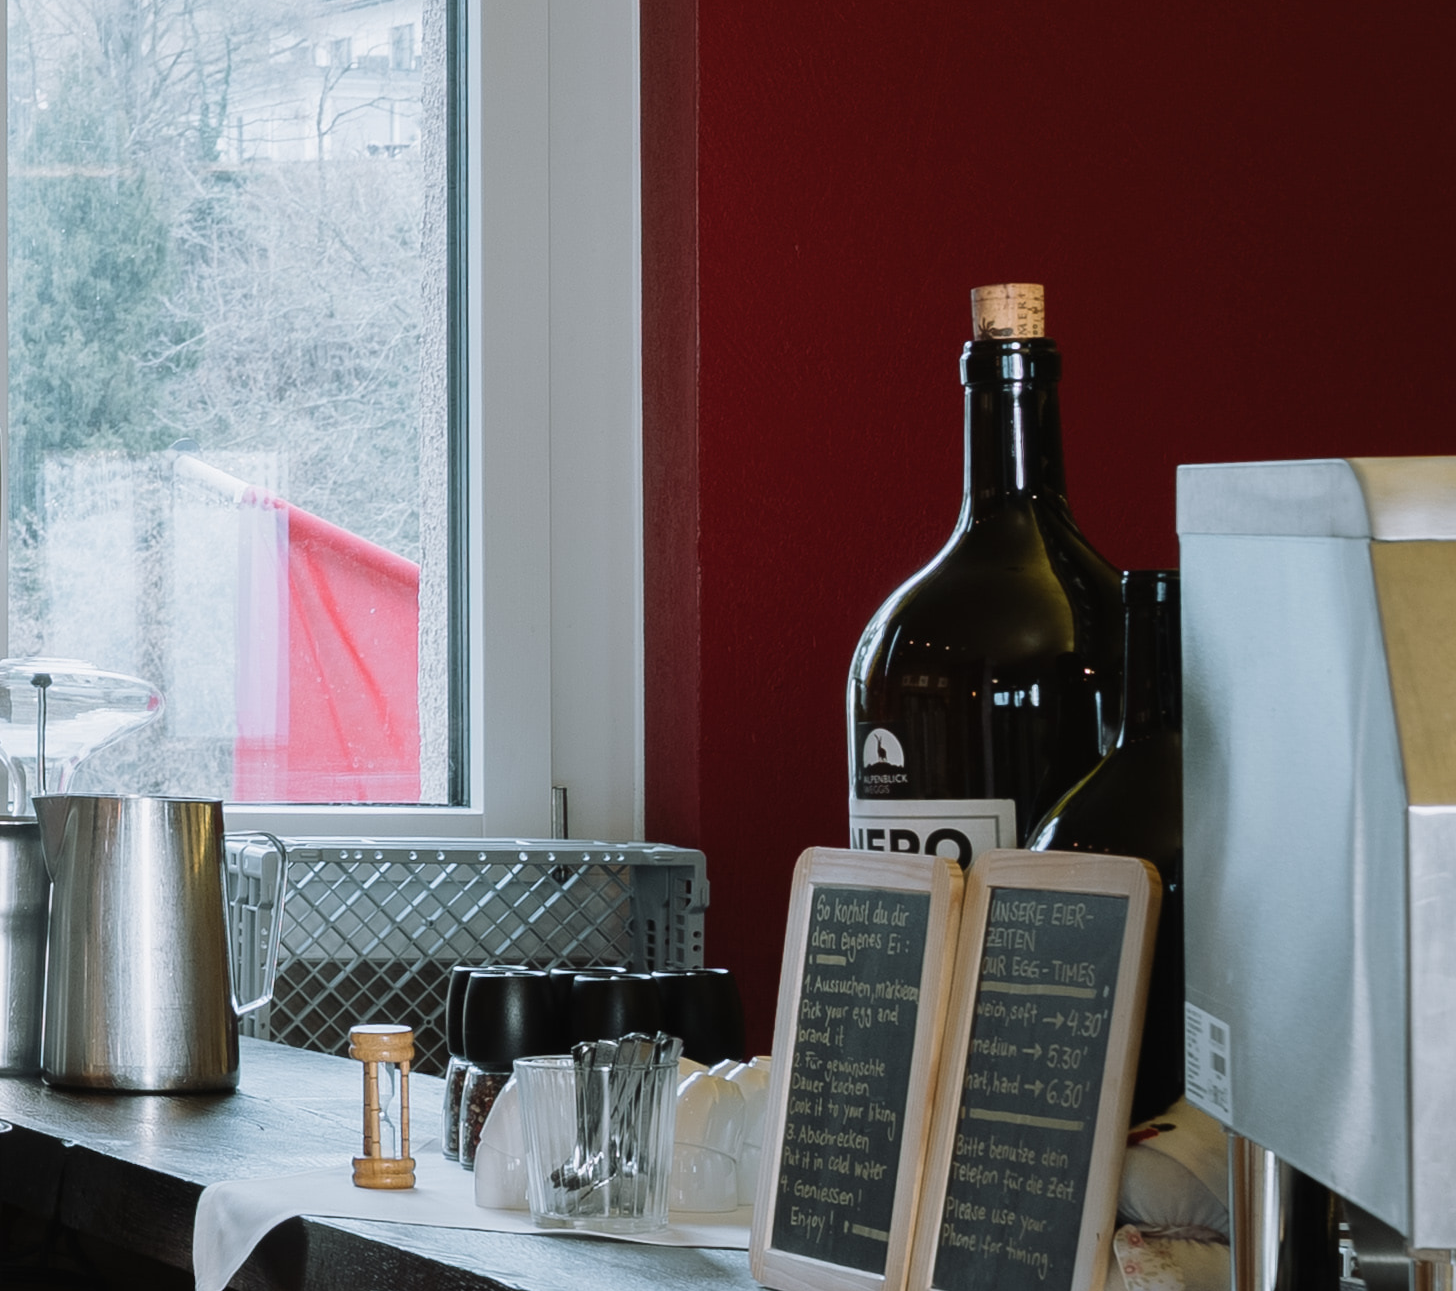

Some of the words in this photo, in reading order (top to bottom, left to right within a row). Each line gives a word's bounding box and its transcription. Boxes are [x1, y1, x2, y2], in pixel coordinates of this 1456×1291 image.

[816, 894, 831, 922] So
[834, 897, 870, 926] kochst
[872, 900, 889, 925] du
[891, 902, 910, 927] dir
[990, 899, 1048, 927] UNSERE
[811, 925, 836, 950] dein
[840, 928, 882, 963] eigenes
[986, 927, 1037, 952] ZEITEN
[801, 998, 822, 1020] Pick
[825, 1004, 849, 1028] your
[852, 1006, 872, 1030] egg
[876, 1004, 899, 1026] and
[798, 1024, 831, 1047] brand
[835, 1024, 845, 1048] it
[791, 1072, 825, 1093] Dauer
[831, 1076, 870, 1097] kochen
[789, 1096, 812, 1115] Cook
[797, 1124, 870, 1154] Abschrecken
[955, 1133, 986, 1157] Bitte
[989, 1135, 1036, 1166] benutze
[1041, 1147, 1070, 1170] dein
[784, 1145, 800, 1167] Put
[802, 1150, 810, 1170] it
[814, 1151, 824, 1171] in
[854, 1163, 888, 1182] water
[952, 1161, 999, 1189] Telefon
[1002, 1169, 1024, 1194] für
[1025, 1173, 1044, 1196] die
[945, 1195, 987, 1222] Please
[991, 1208, 1017, 1227] use
[1020, 1214, 1048, 1241] your
[941, 1223, 977, 1252] Phone
